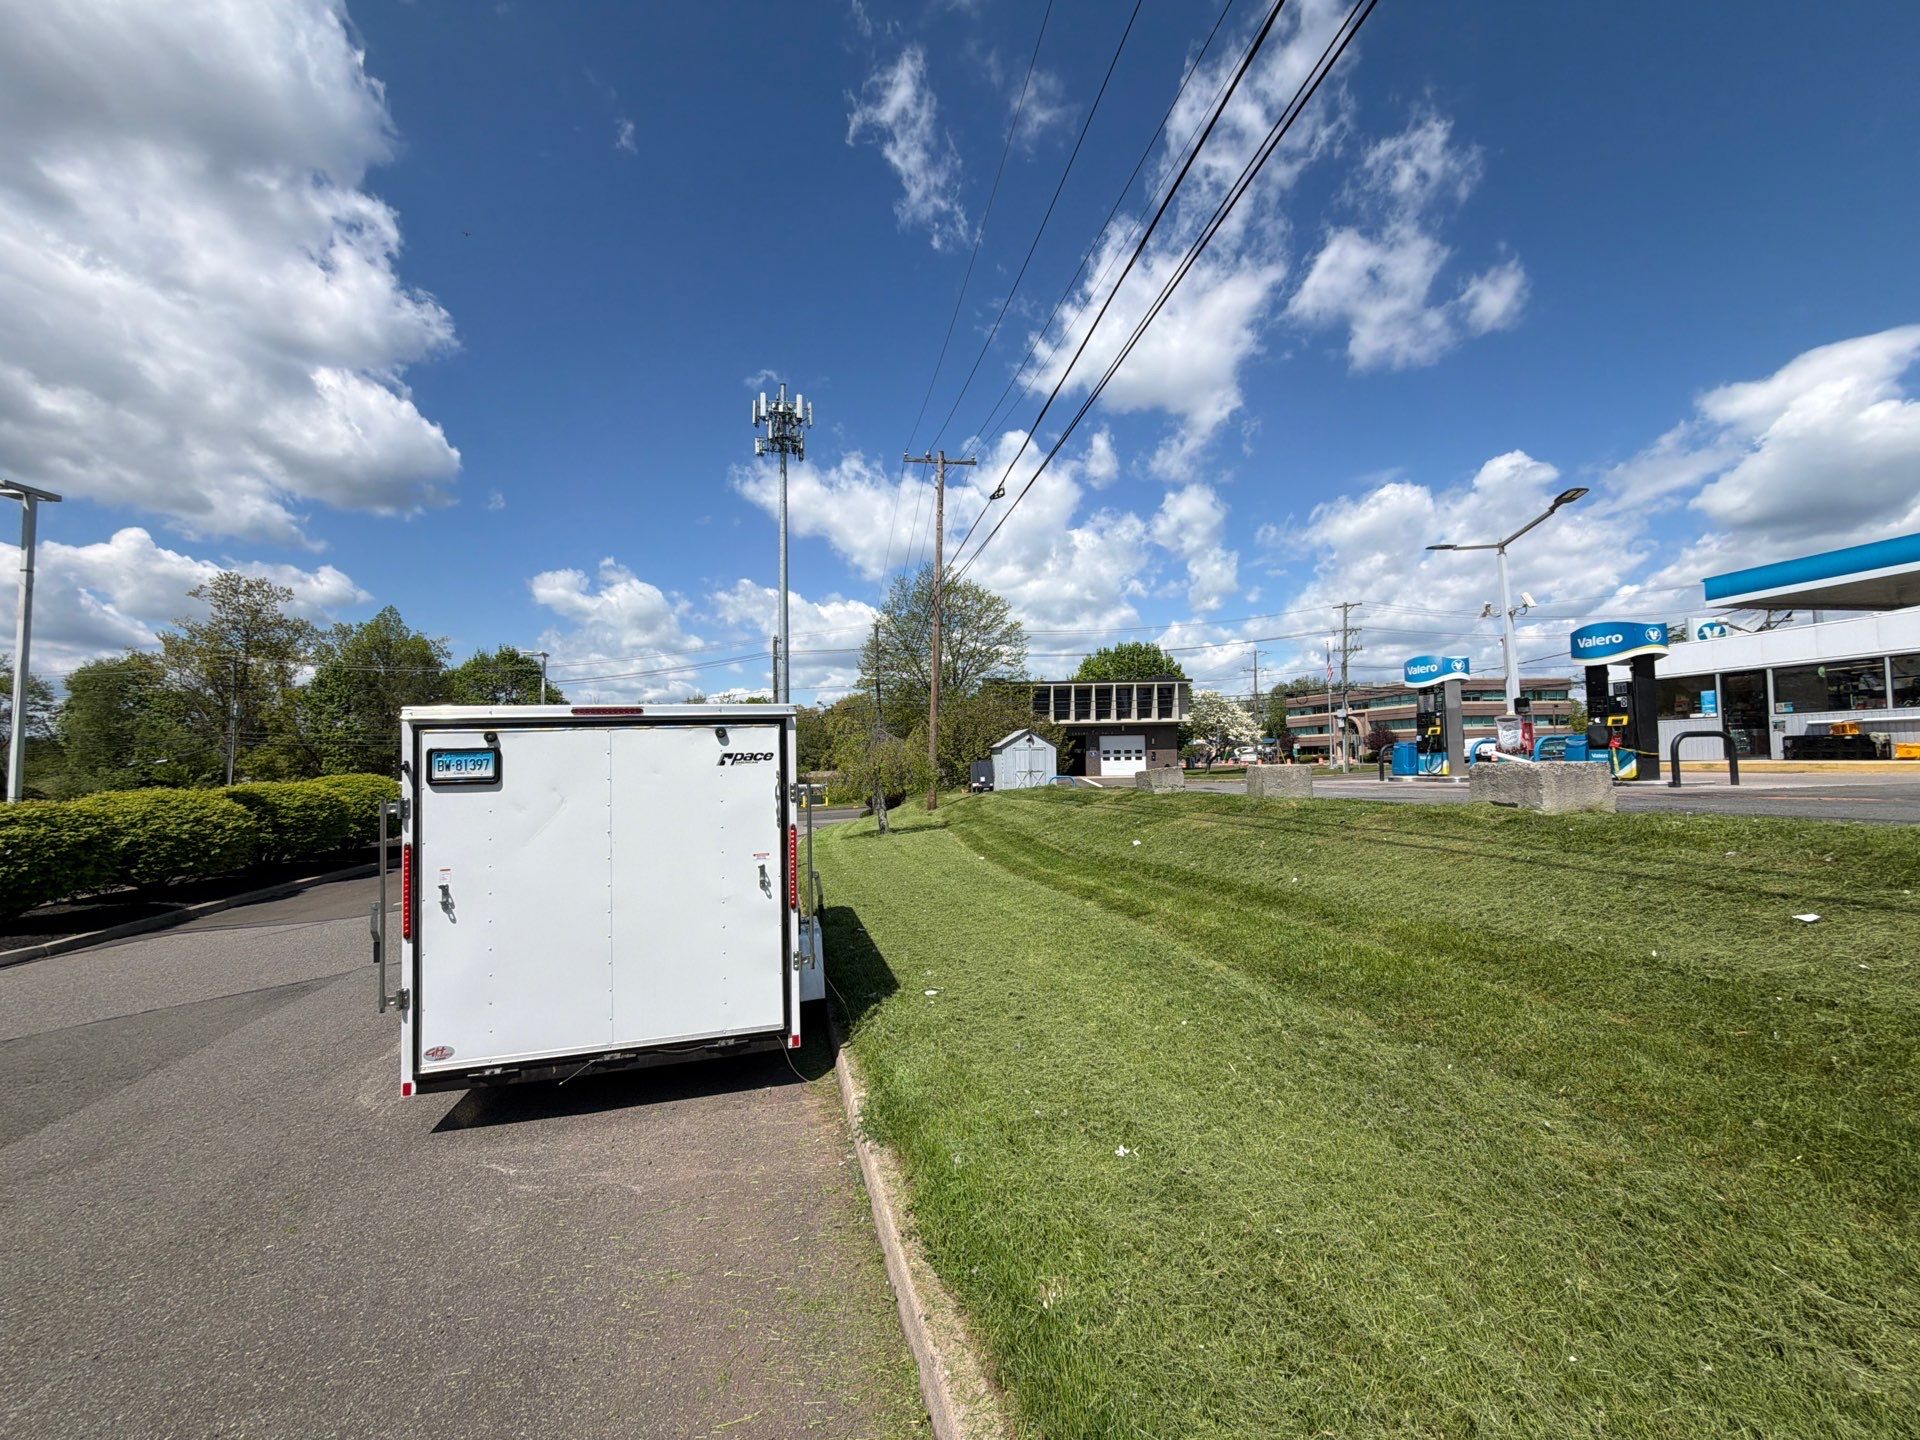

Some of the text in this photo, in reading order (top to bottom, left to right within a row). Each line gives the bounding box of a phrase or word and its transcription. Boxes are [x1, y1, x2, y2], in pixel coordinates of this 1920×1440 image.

[1577, 633, 1623, 648] Valero
[1407, 664, 1438, 675] Valero
[730, 752, 774, 766] pace
